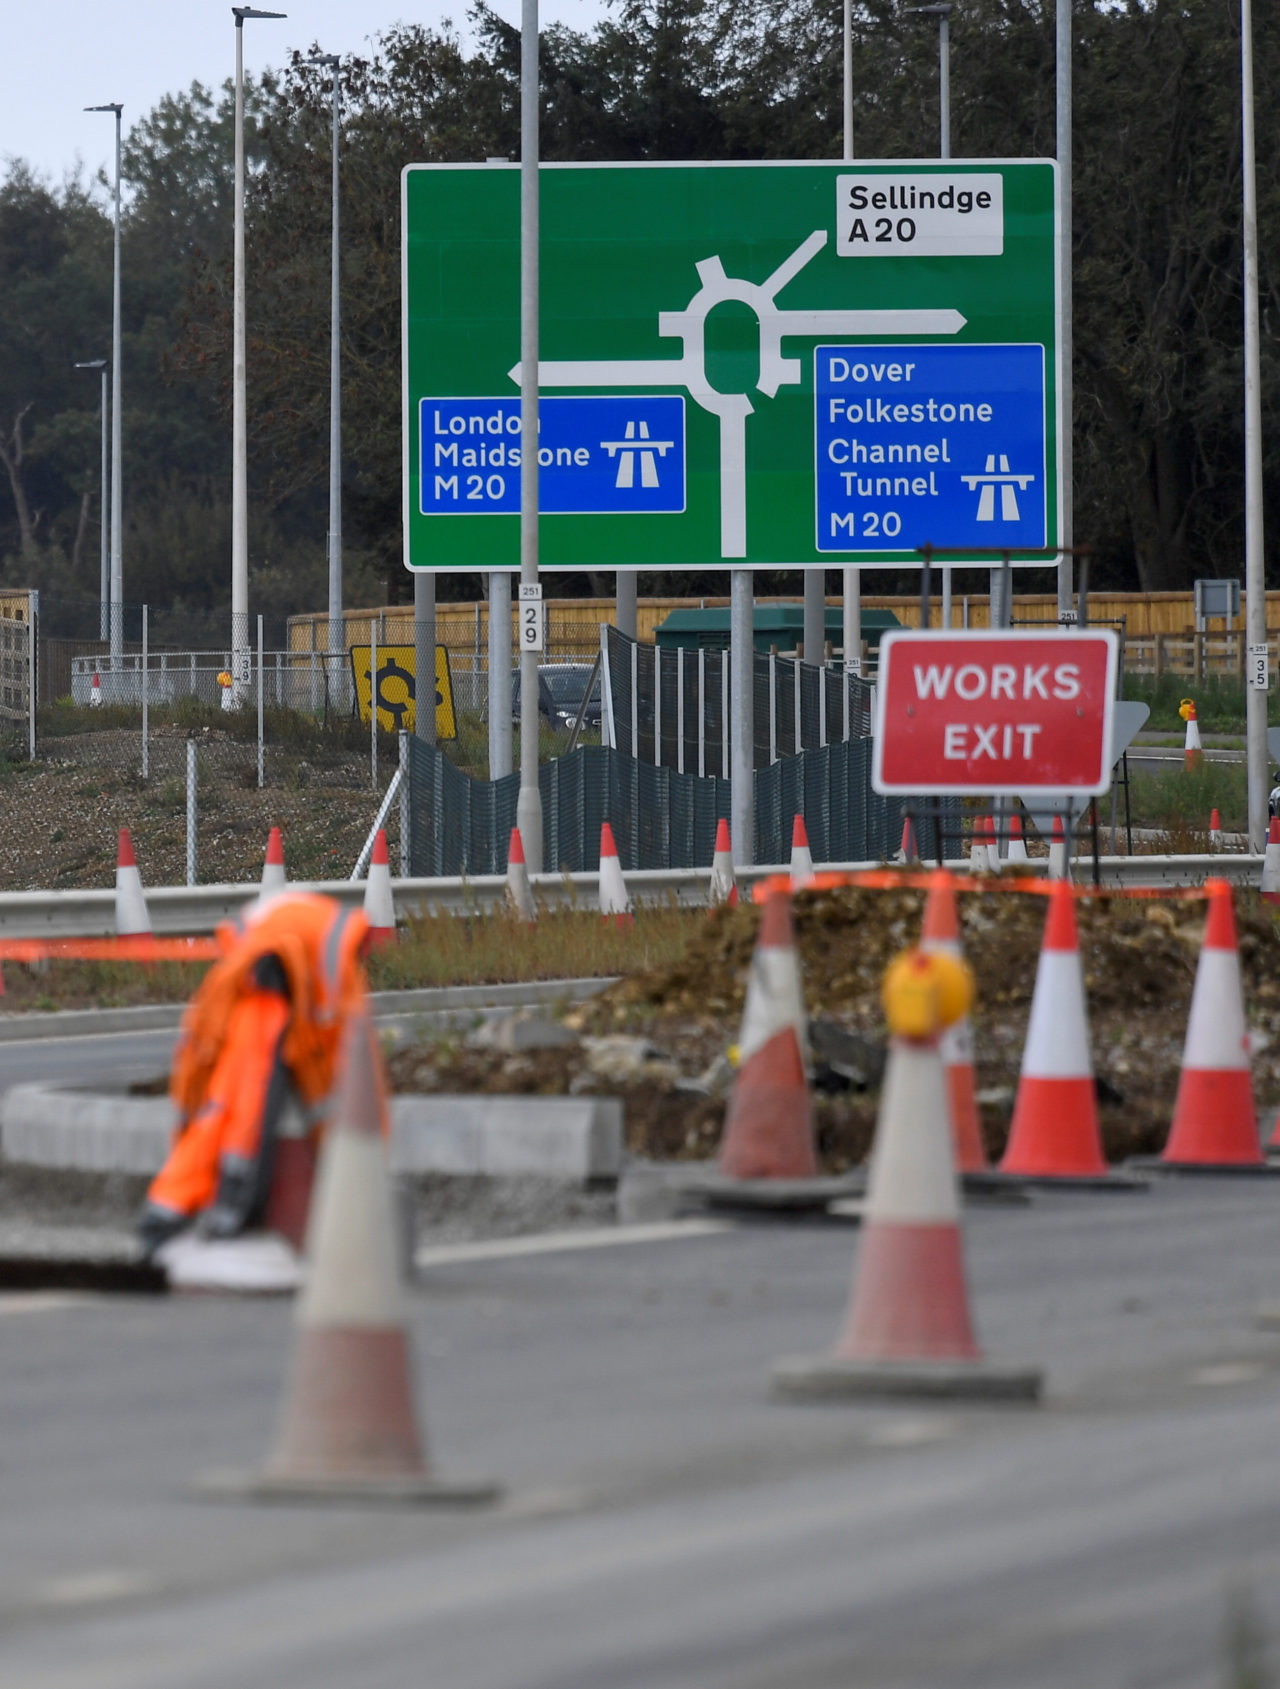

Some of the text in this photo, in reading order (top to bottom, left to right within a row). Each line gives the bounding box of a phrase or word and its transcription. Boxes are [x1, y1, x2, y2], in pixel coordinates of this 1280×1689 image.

[848, 185, 992, 214] Sellindge
[829, 357, 916, 382] Dover
[434, 410, 541, 435] Londo
[829, 398, 993, 423] Folkestone
[434, 442, 590, 467] Maidsone
[828, 438, 951, 464] Channel
[840, 471, 939, 496] Tunnel
[523, 587, 539, 596] 251
[913, 664, 1081, 701] WORKS
[943, 723, 1042, 760] EXIT
